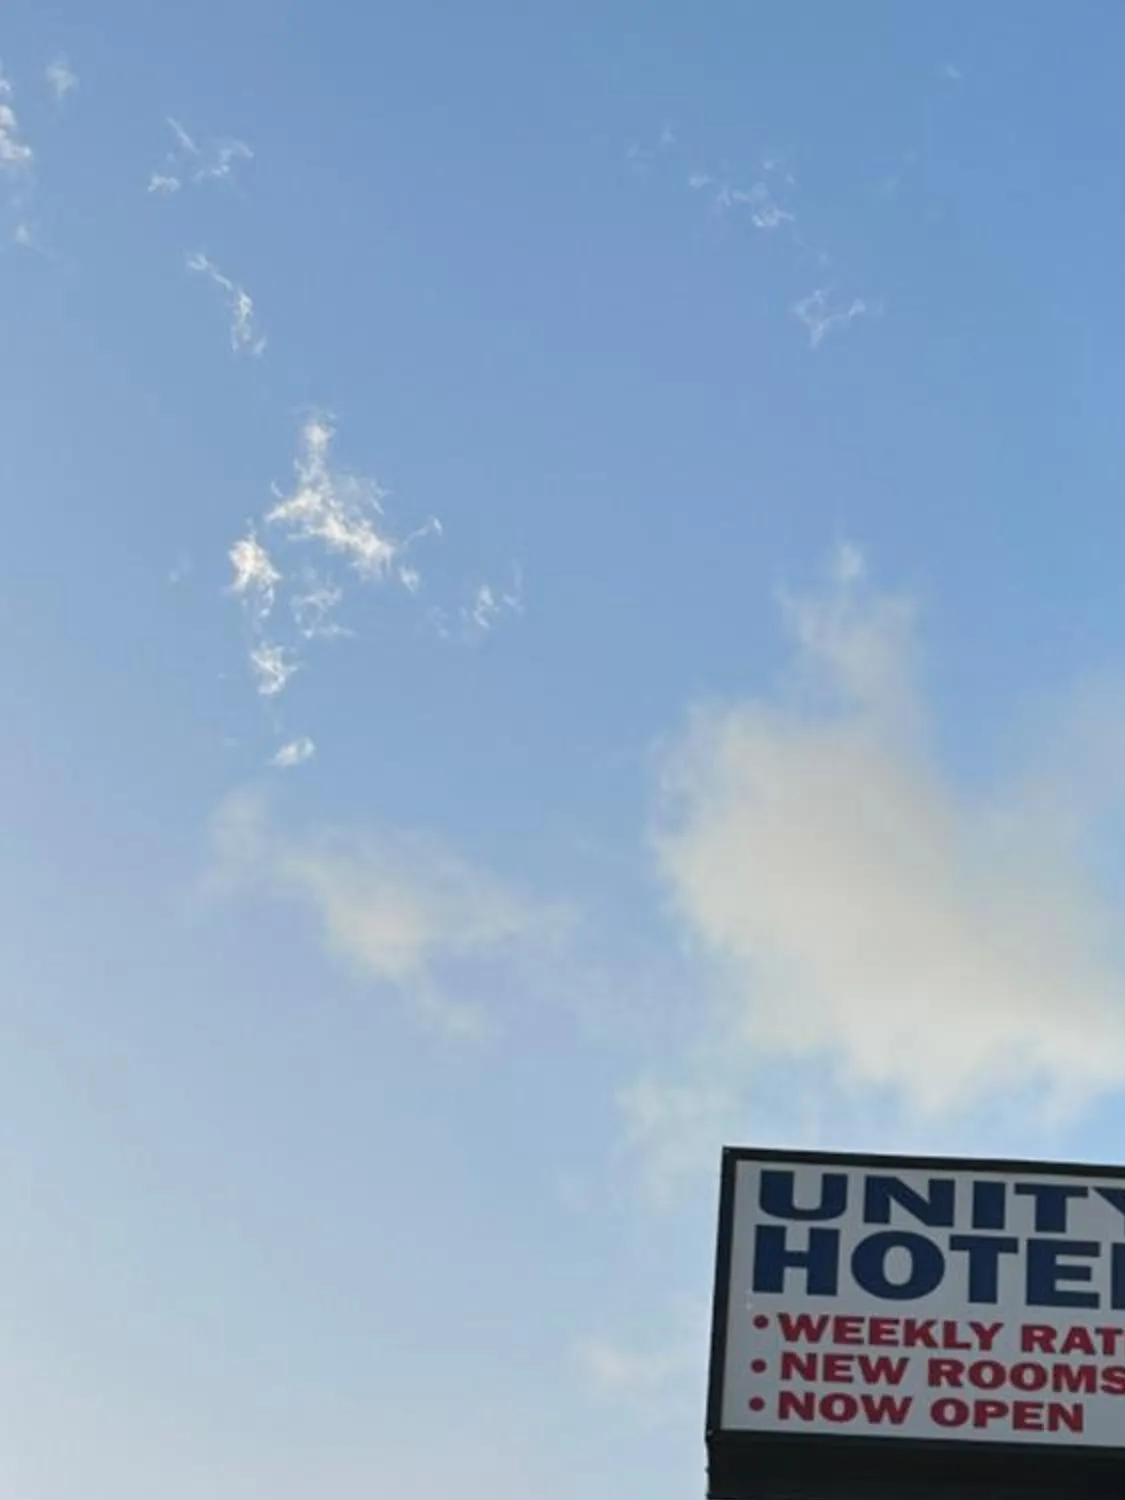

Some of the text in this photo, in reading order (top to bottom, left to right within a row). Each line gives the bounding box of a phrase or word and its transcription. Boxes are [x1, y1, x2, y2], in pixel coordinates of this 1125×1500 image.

[777, 1313, 1004, 1353] WEEKLY
[780, 1352, 910, 1386] NEW
[778, 1391, 1085, 1433] NOW OPEN
